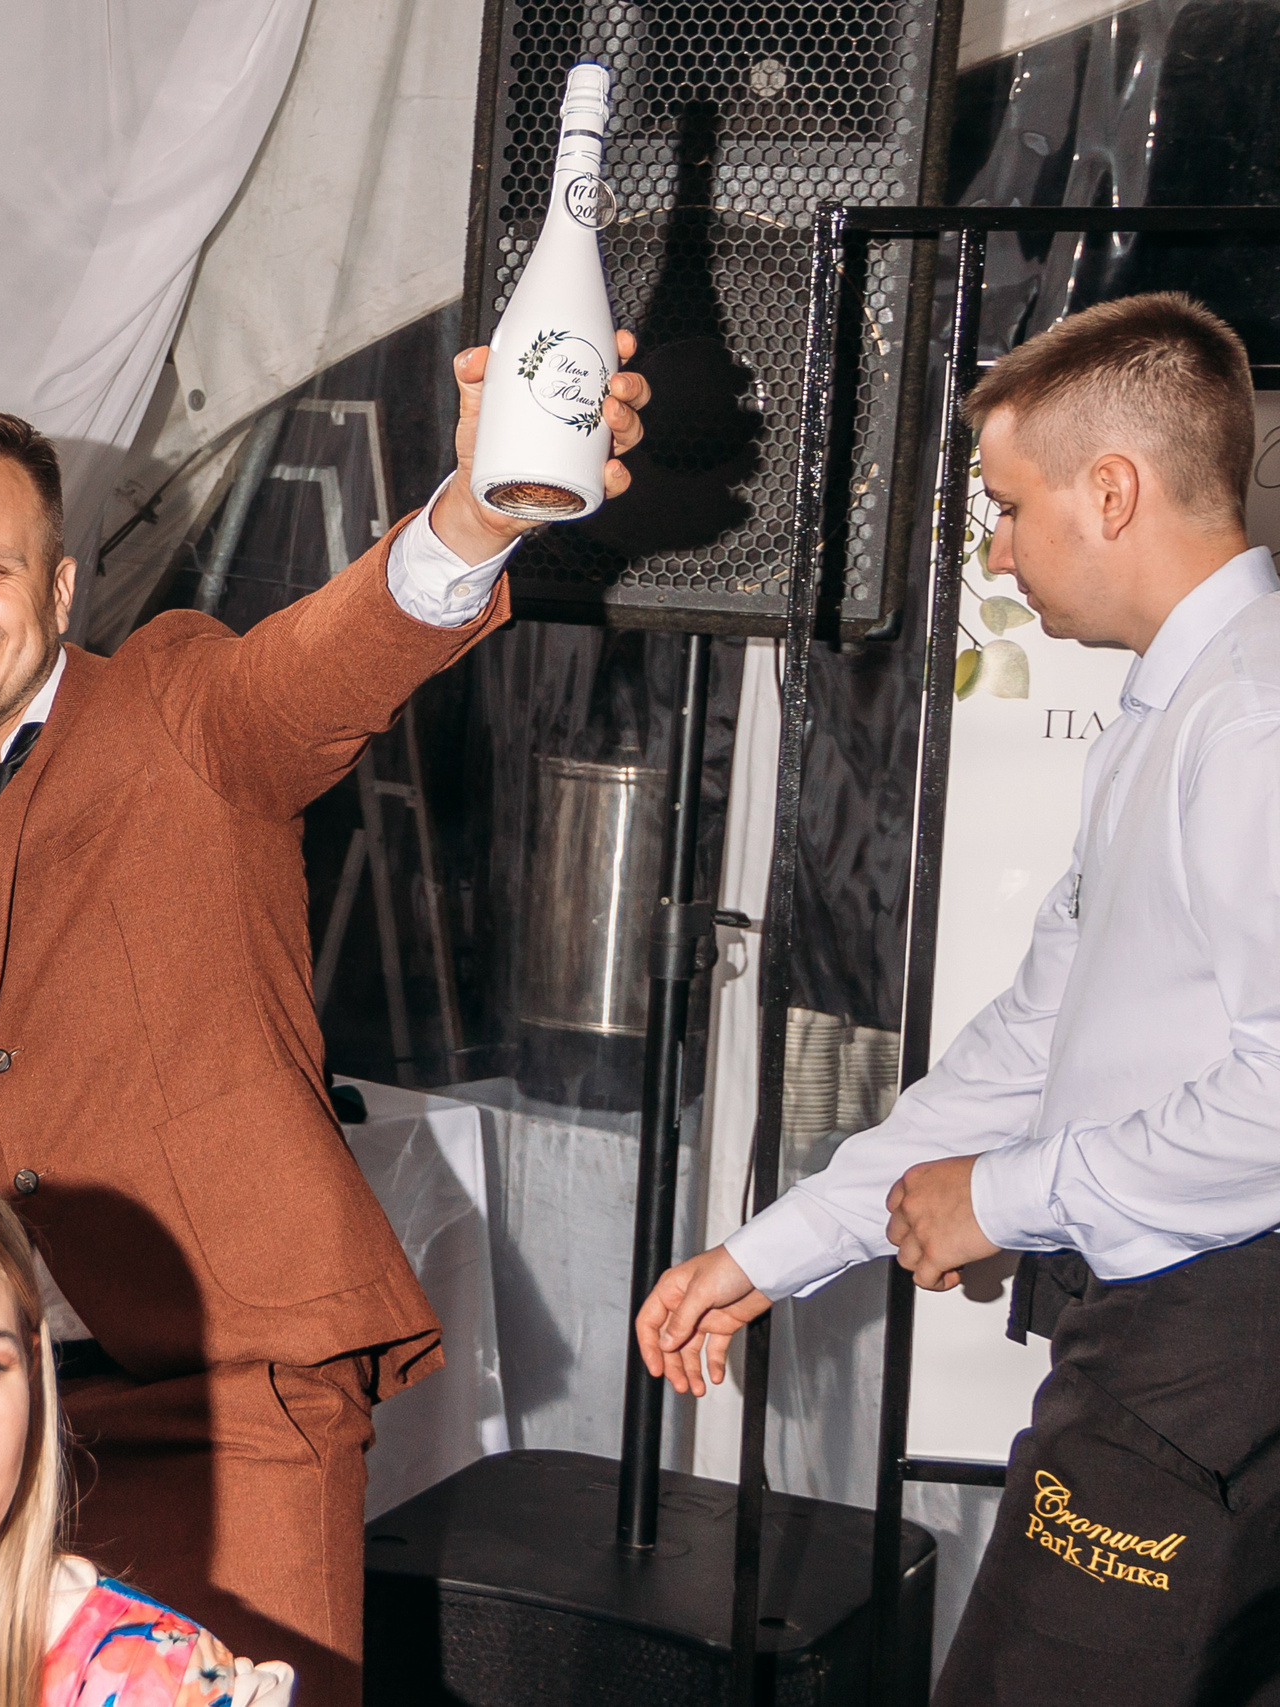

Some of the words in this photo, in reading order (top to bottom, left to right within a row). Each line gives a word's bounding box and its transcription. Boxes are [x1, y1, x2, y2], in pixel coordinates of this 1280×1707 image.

[575, 204, 599, 219] 202
[548, 353, 589, 377] Илья
[539, 380, 596, 406] Юлия
[571, 376, 582, 384] и
[1040, 709, 1105, 740] ПЛ
[1034, 1470, 1187, 1562] Cronwell
[1025, 1513, 1084, 1567] Park
[1086, 1545, 1170, 1591] Ника
